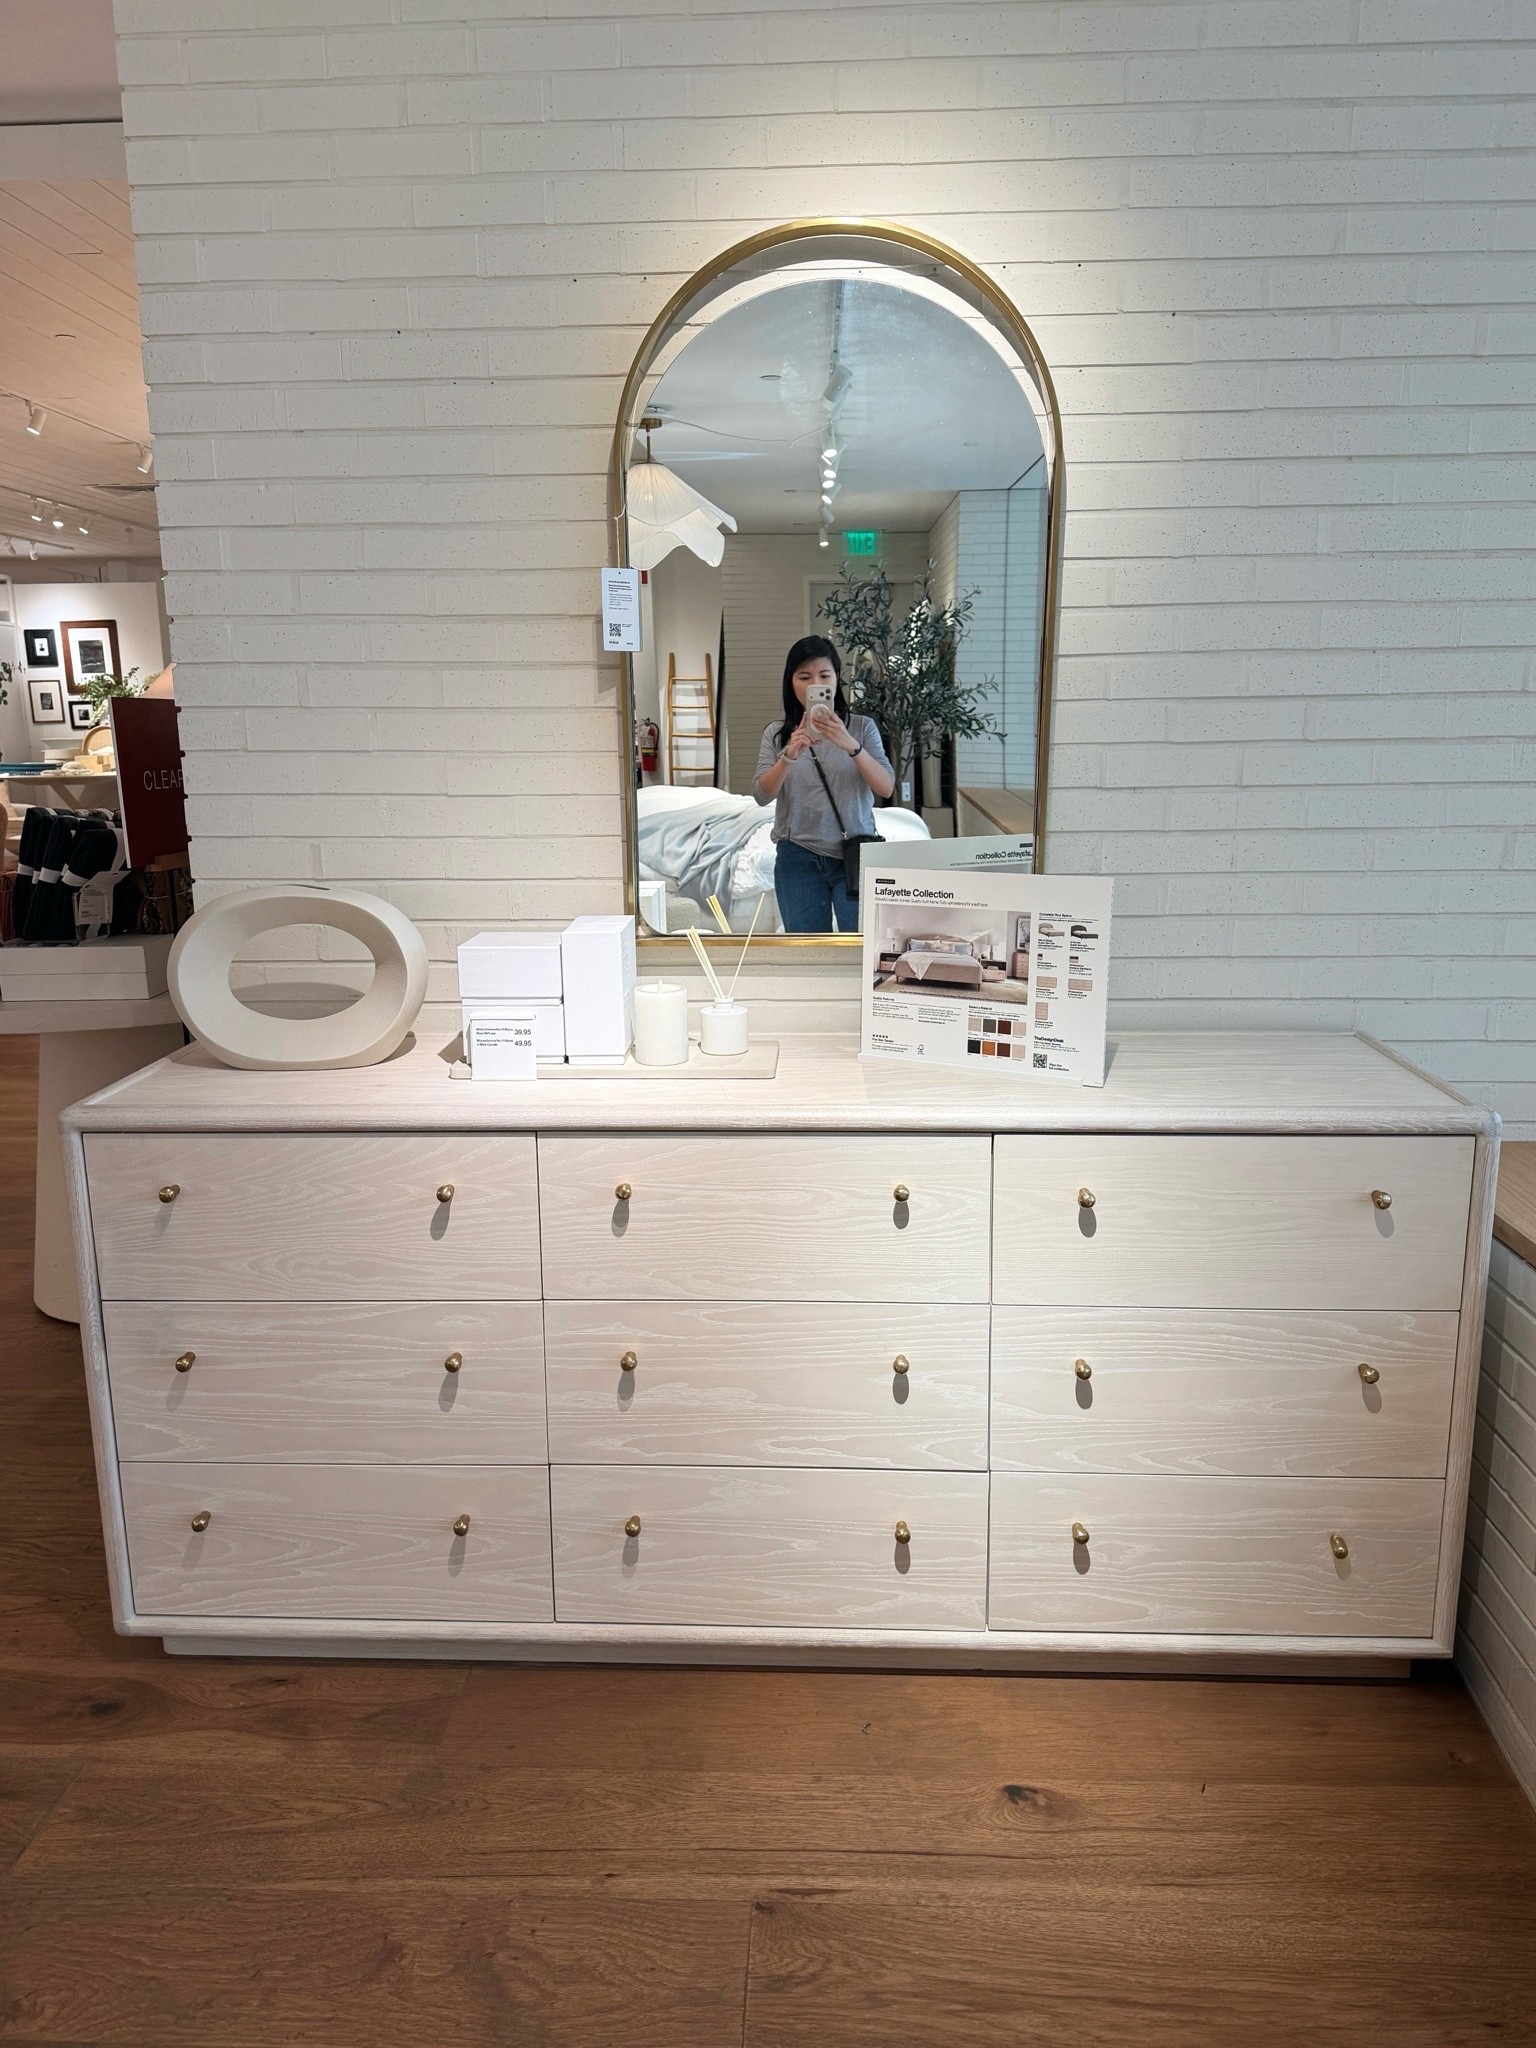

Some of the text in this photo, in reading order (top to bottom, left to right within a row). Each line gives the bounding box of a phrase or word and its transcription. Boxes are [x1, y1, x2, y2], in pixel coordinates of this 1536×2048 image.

[875, 886, 954, 899] Lafayette Collection
[514, 1028, 532, 1036] 39.95
